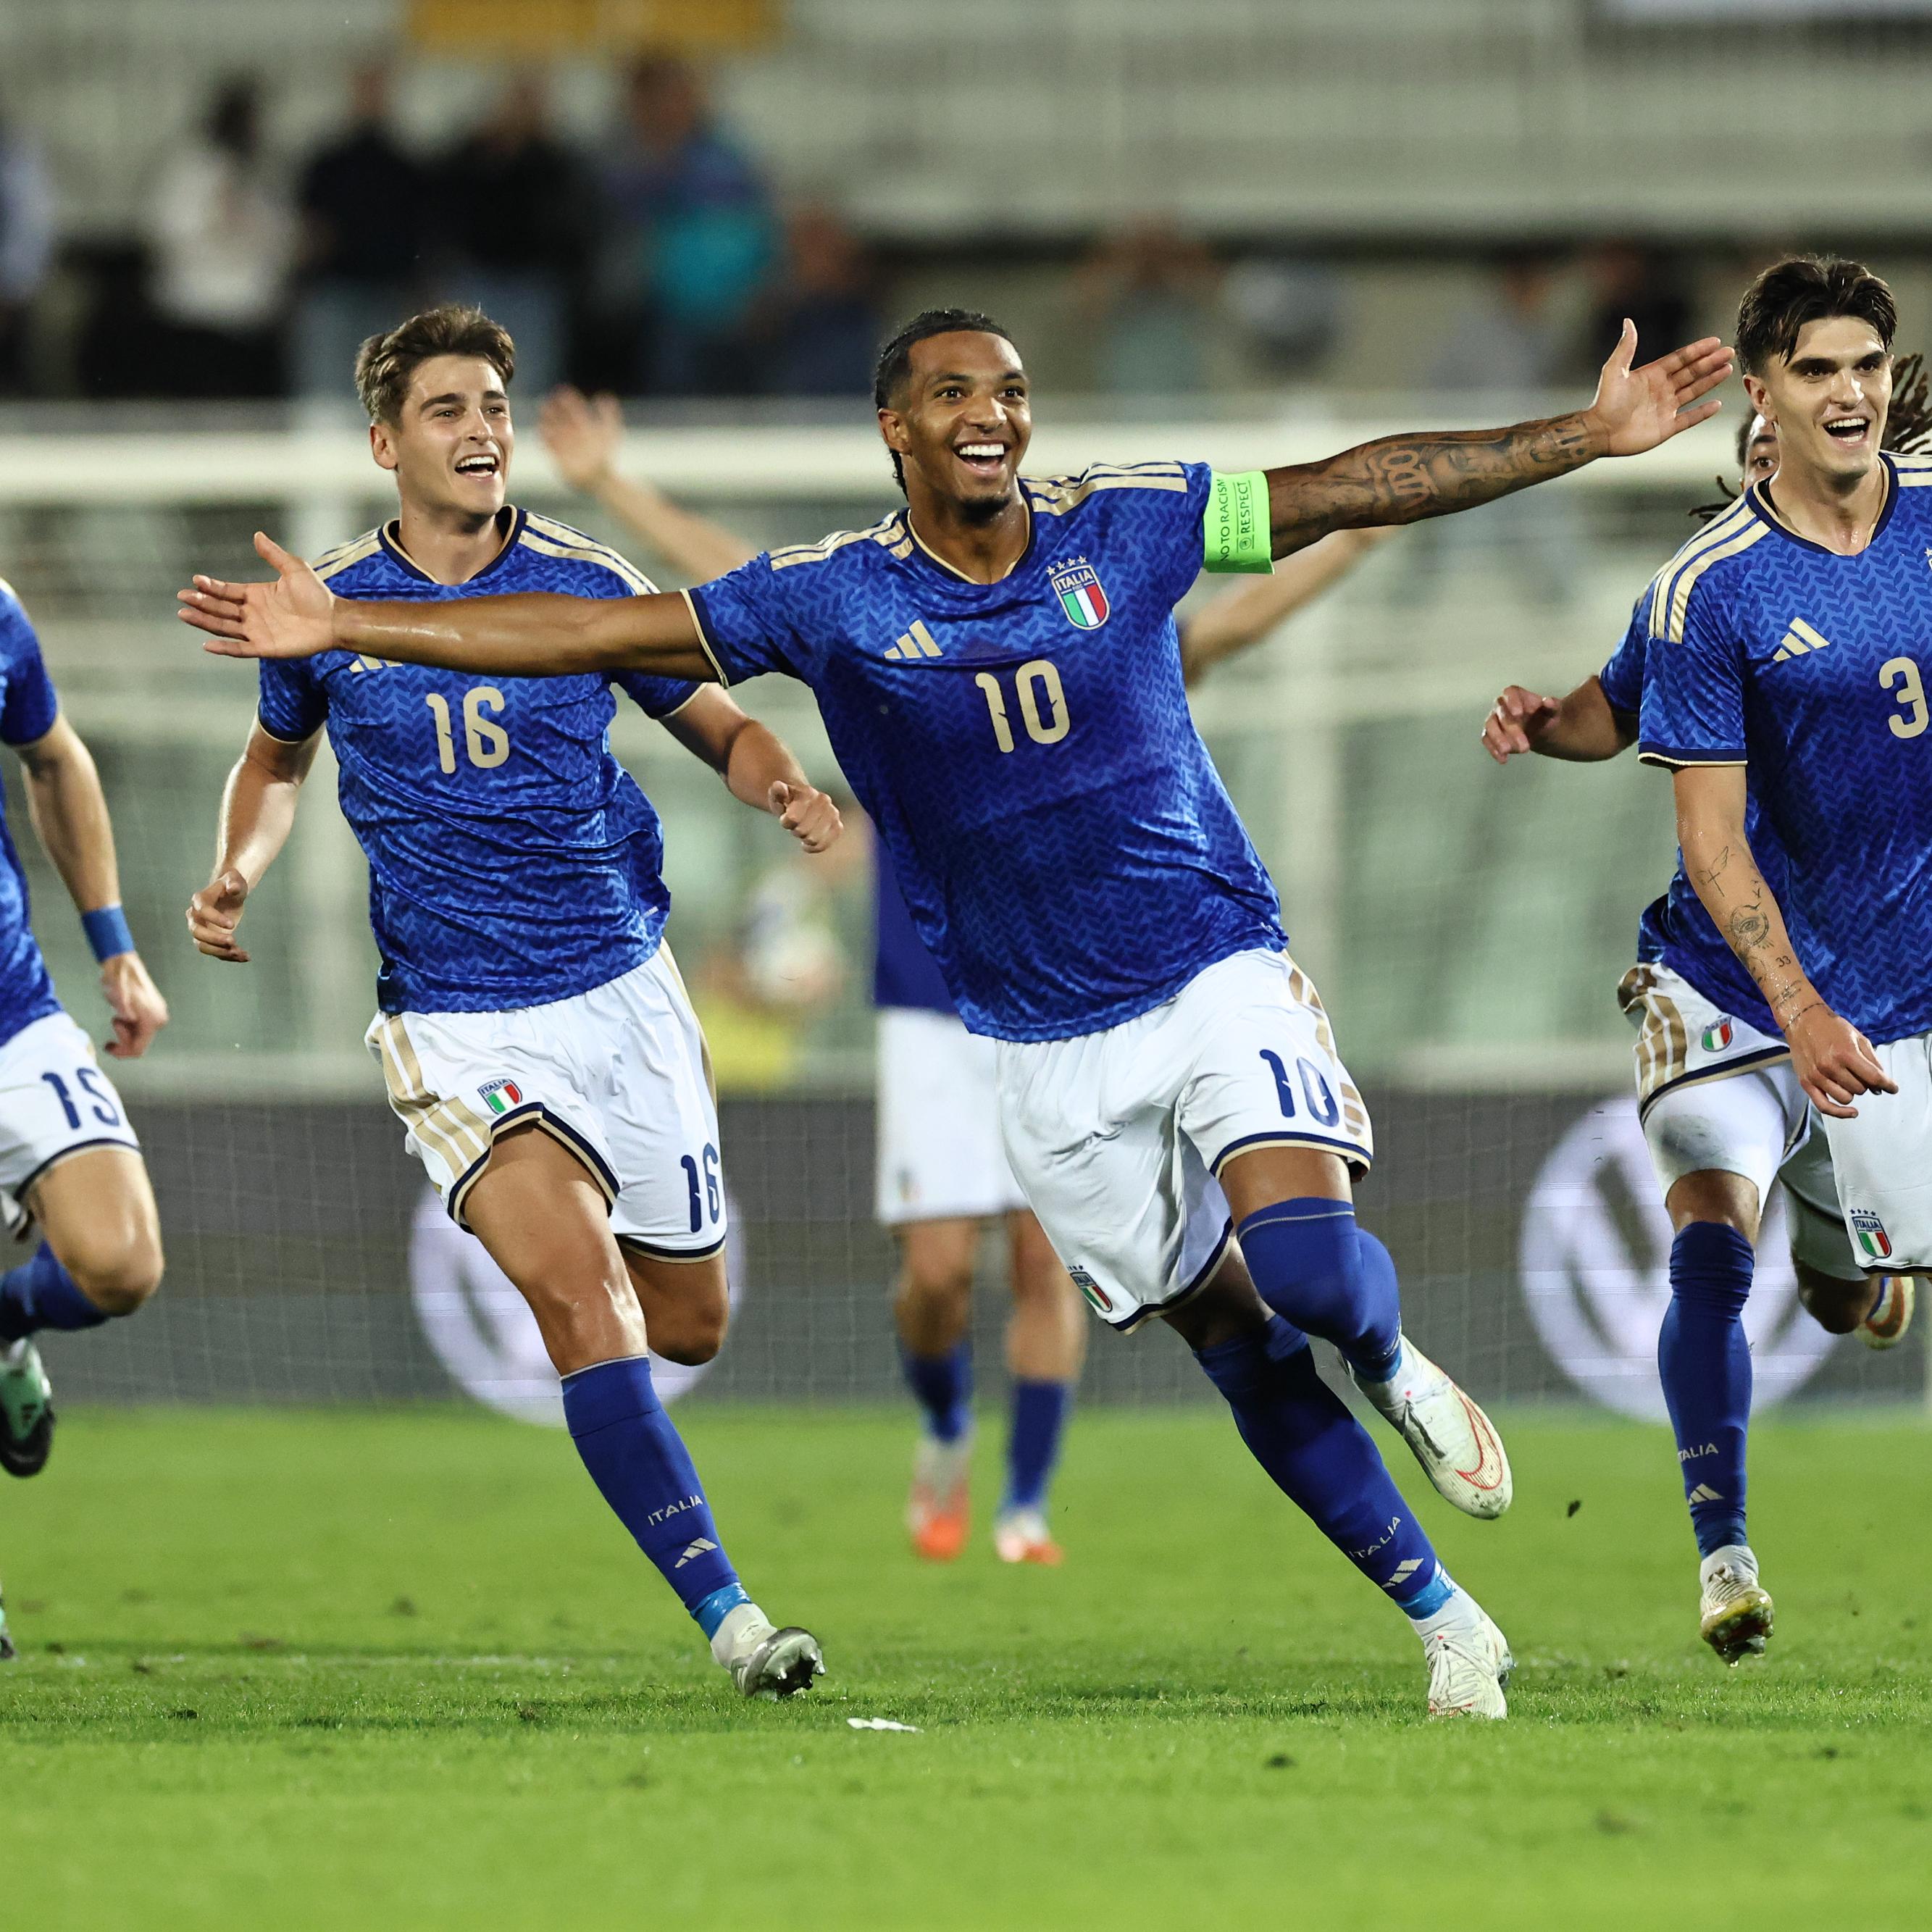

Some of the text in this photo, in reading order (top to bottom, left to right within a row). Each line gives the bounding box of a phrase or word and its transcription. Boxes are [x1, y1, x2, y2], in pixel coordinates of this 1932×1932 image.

[1216, 479, 1229, 522] RACISM
[1237, 482, 1250, 533] RESPECT
[1221, 527, 1230, 544] TO
[1055, 569, 1093, 591] ITALIA
[975, 660, 1071, 753] 10
[1878, 656, 1930, 739] 3
[425, 686, 510, 774] 16
[480, 1079, 509, 1095] ITALIA
[1259, 1049, 1339, 1127] 10
[680, 1142, 720, 1233] 16
[1855, 1220, 1881, 1229] ITALIA
[1678, 1442, 1719, 1462] TALIA
[648, 1494, 703, 1526] ITALIA
[1348, 1517, 1401, 1558] ITALIA
